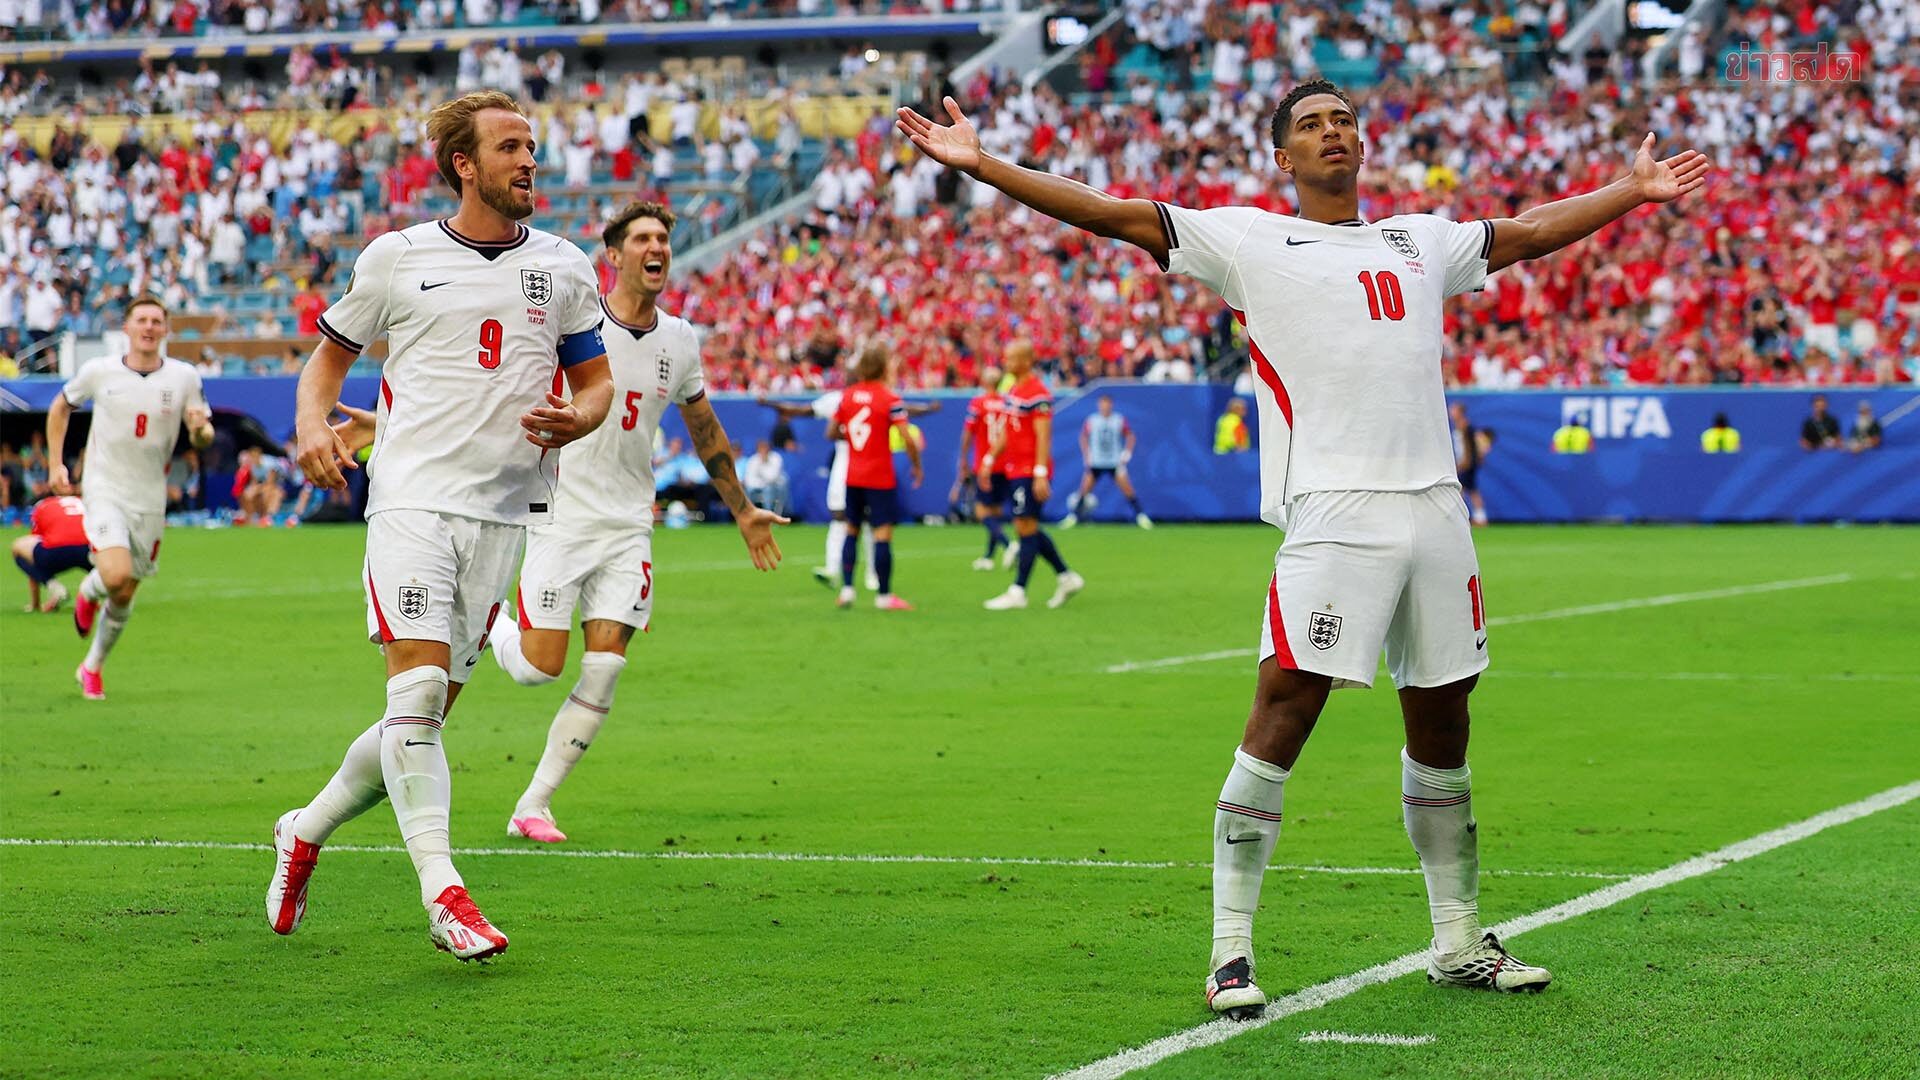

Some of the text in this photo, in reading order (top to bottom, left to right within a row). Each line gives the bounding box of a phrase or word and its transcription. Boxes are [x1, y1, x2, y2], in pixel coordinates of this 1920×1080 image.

[1358, 270, 1406, 321] 10
[478, 318, 503, 370] 9
[135, 413, 148, 439] 8
[621, 389, 643, 432] 5
[847, 404, 872, 452] 6
[1561, 396, 1672, 439] FIFA
[640, 560, 652, 601] 5
[1467, 574, 1486, 632] 1
